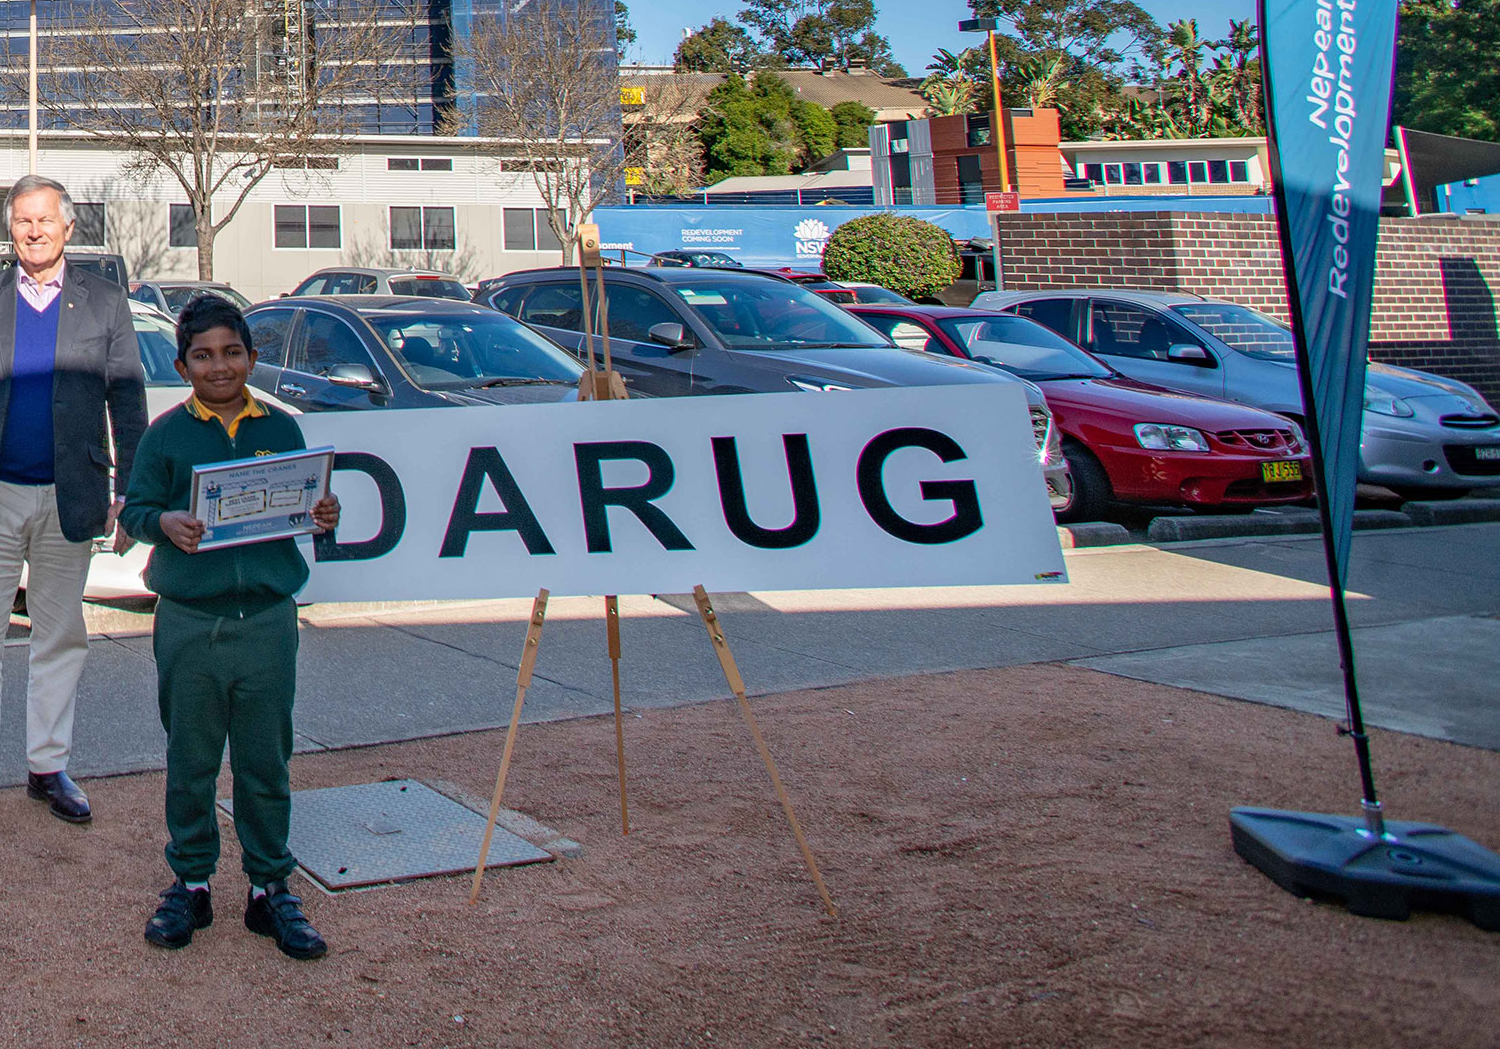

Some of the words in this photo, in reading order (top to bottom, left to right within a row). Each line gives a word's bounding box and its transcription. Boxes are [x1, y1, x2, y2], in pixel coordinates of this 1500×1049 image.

[1328, 0, 1357, 299] Redevelopment
[228, 471, 249, 479] NAME
[267, 464, 297, 472] CRANES
[312, 426, 985, 563] DARUG
